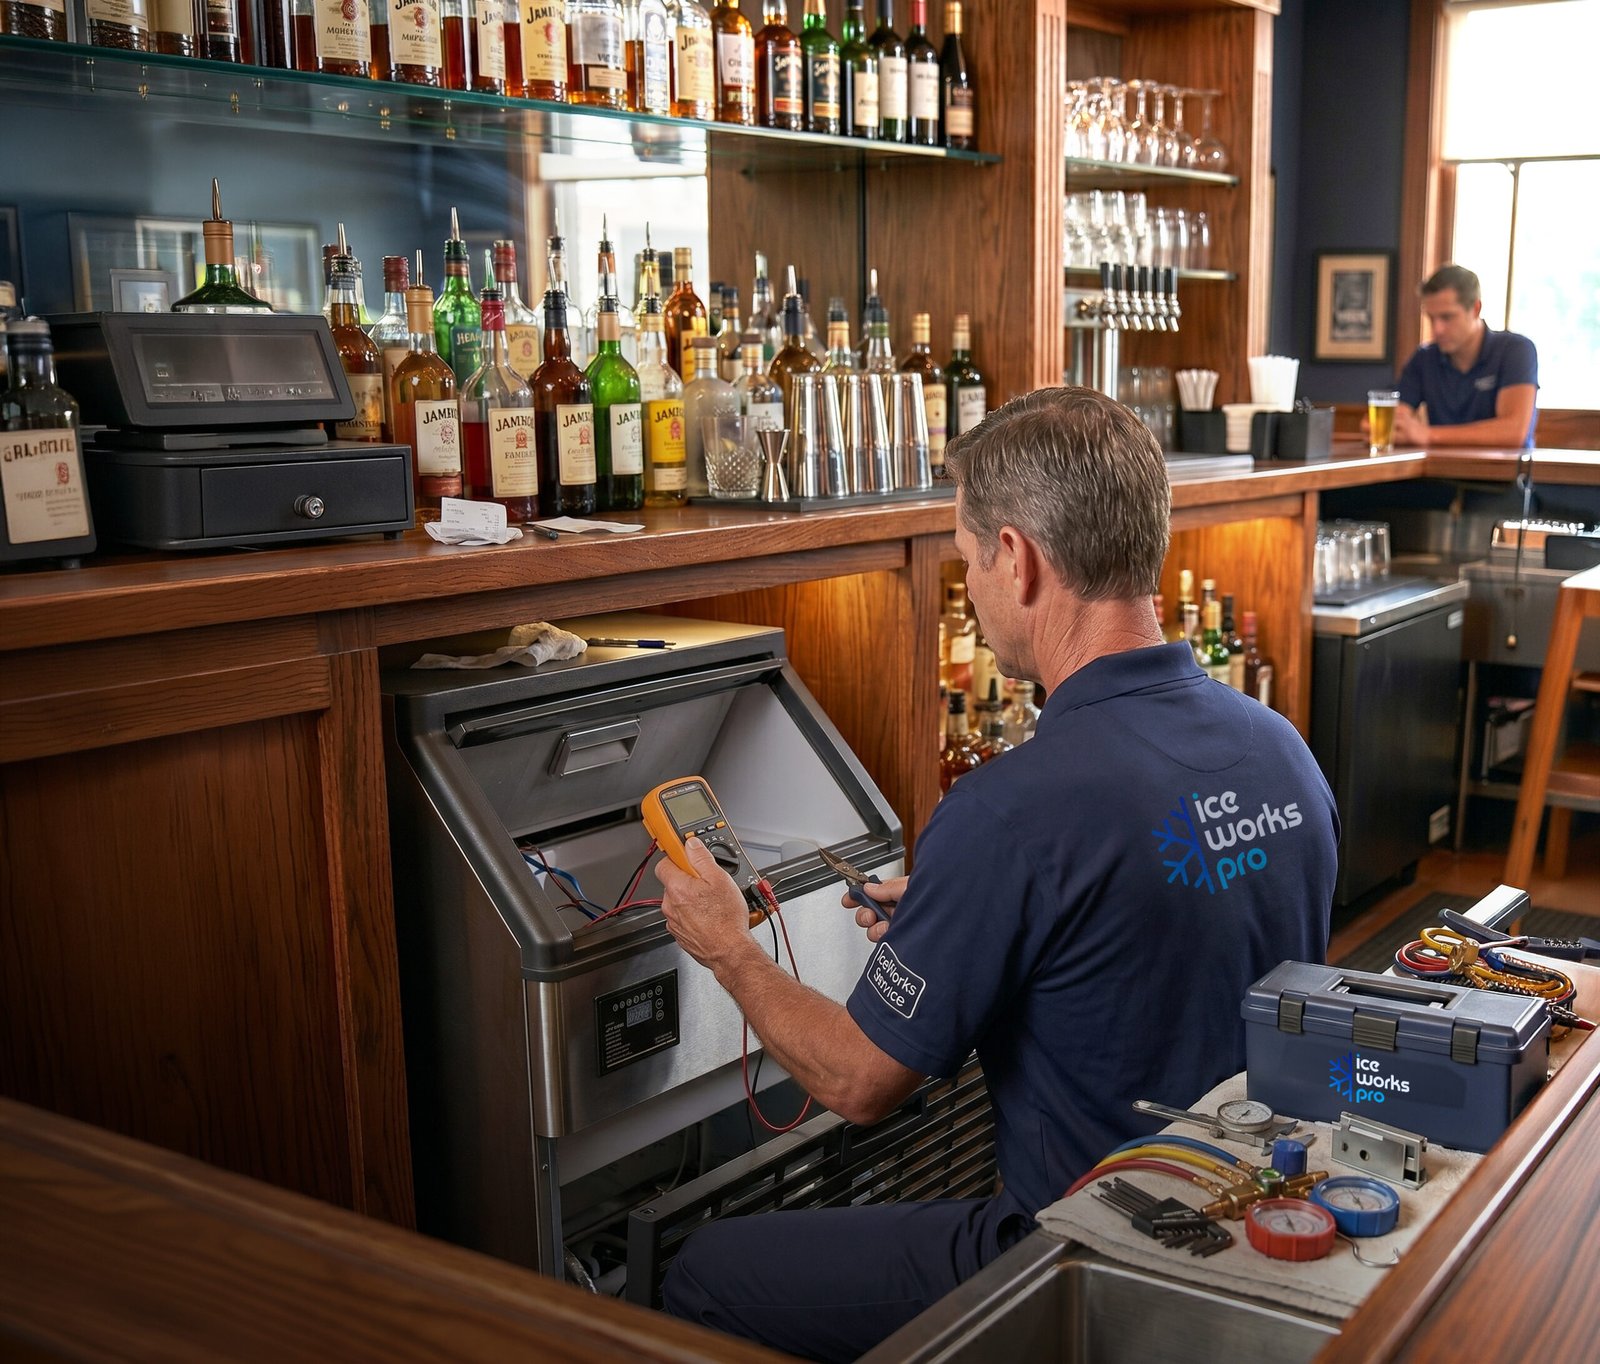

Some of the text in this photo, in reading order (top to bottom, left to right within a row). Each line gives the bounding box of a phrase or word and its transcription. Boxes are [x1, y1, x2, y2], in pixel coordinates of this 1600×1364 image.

[1192, 791, 1240, 824] ice
[1204, 802, 1303, 851] works
[1216, 847, 1267, 890] pro
[877, 949, 917, 996] IceWorks
[1356, 1053, 1380, 1072] ice
[1356, 1072, 1410, 1093] works
[1356, 1088, 1385, 1104] pro
